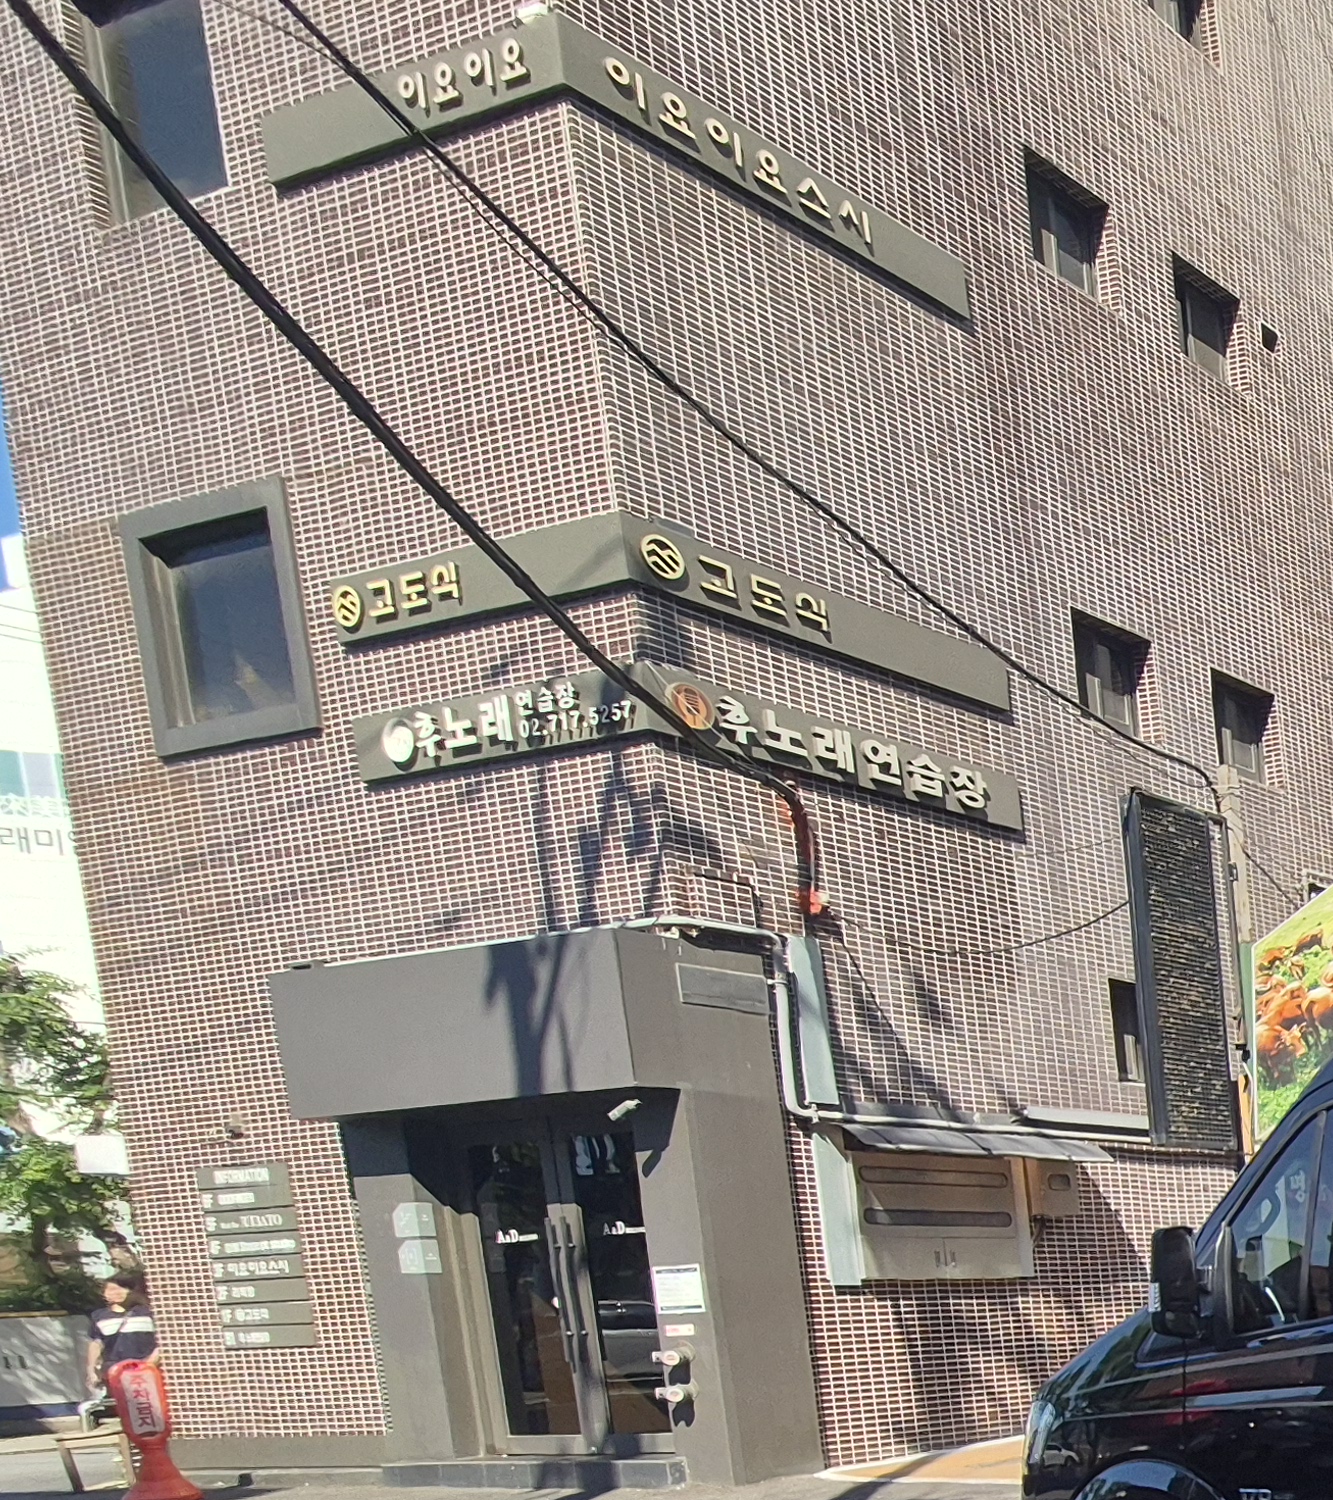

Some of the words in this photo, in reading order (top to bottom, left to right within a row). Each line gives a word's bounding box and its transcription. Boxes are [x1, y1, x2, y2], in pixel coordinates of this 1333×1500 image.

[397, 36, 528, 110] 이요이요
[604, 56, 872, 245] 이요이요스시
[366, 560, 460, 617] 고도식
[698, 554, 829, 632] 고도식
[513, 680, 577, 716] 연습장
[518, 700, 634, 739] 02.717.5257
[715, 694, 988, 809] 후노래연습장
